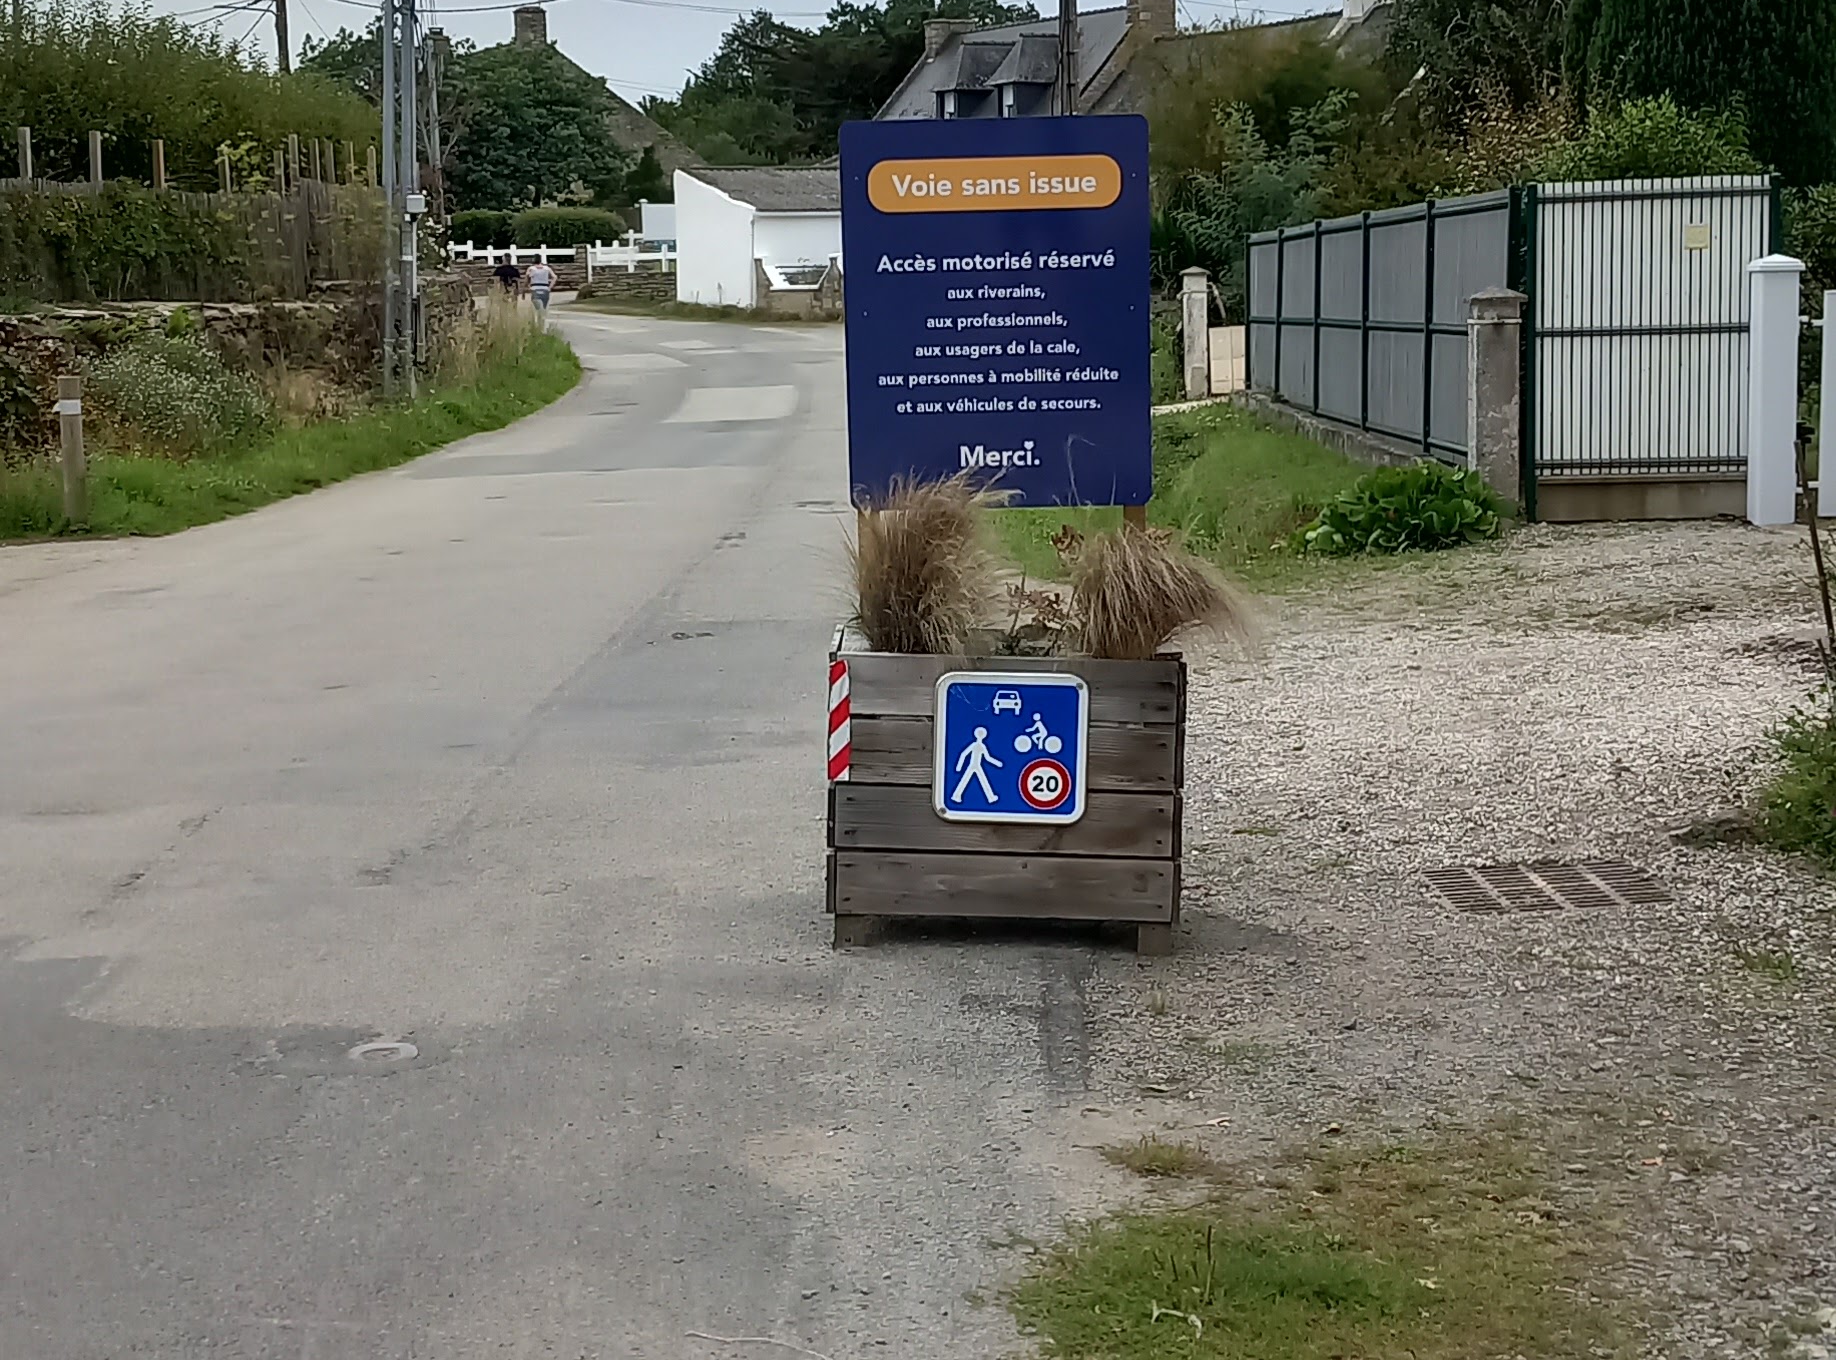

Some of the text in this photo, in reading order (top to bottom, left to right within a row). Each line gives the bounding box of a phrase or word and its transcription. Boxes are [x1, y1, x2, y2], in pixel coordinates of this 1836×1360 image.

[891, 171, 1097, 197] Voie sans issue
[876, 248, 1115, 273] Accès motorisé réservé
[947, 283, 1046, 300] aux riverains,
[926, 311, 1068, 331] aux professionnels,
[915, 339, 1080, 359] aux usagers de la cale,
[878, 366, 1119, 389] aux personnes à mobilité réduite
[896, 396, 1101, 413] et aux véhicules de secours.
[959, 440, 1041, 467] Merci.
[1031, 774, 1059, 793] 20
